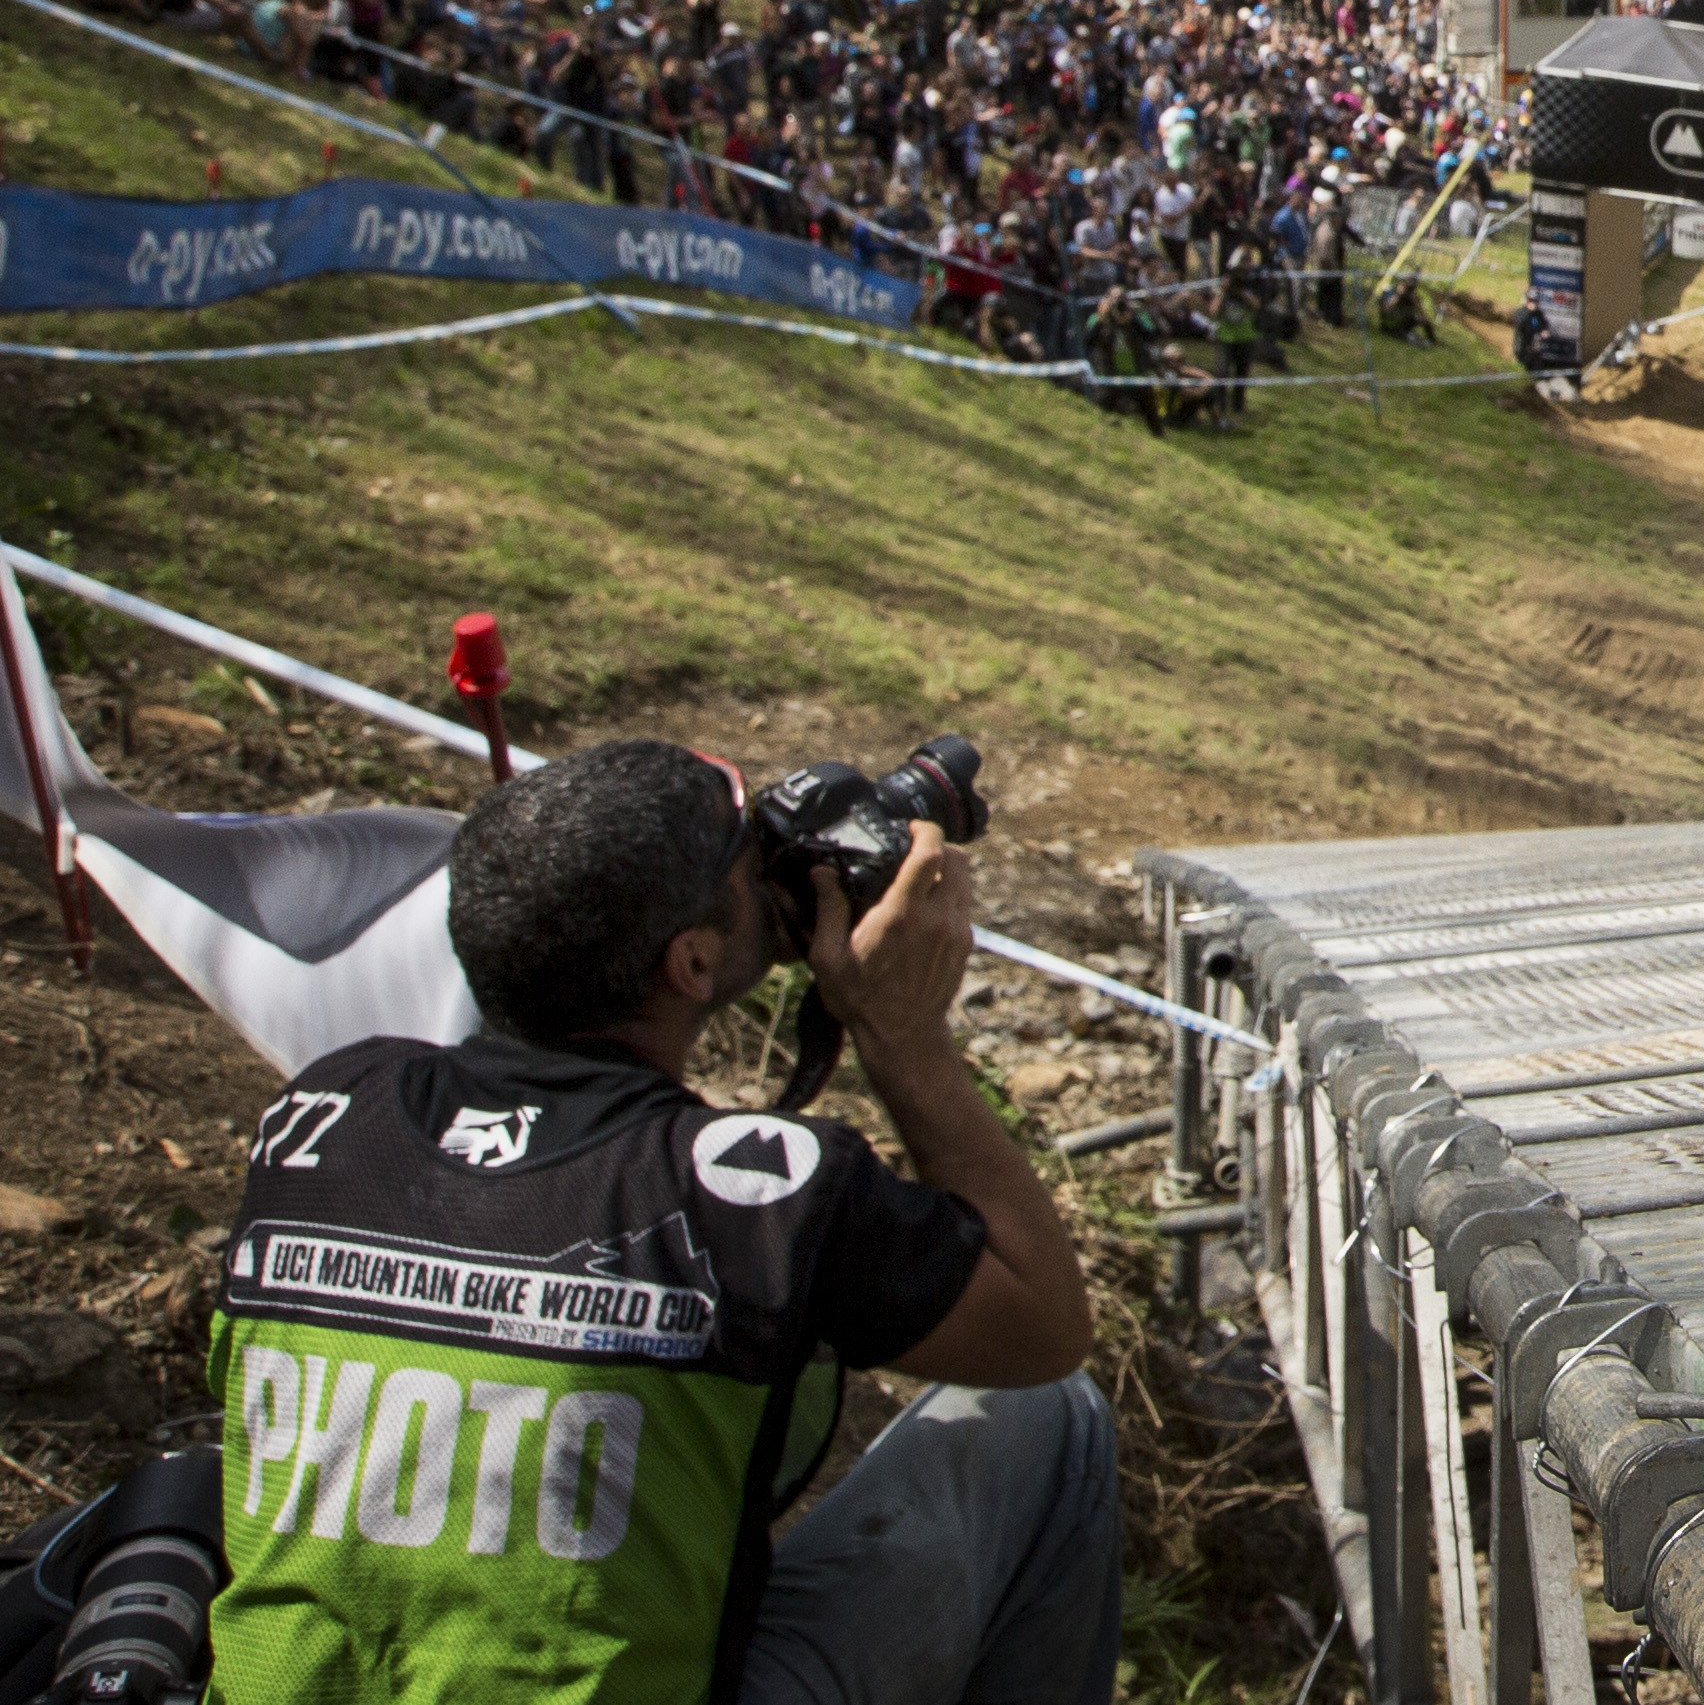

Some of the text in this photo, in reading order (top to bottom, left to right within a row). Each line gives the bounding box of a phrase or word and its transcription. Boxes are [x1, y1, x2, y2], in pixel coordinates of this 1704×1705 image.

[352, 204, 531, 270] n-py.com
[272, 1243, 316, 1283] UCI
[317, 1247, 459, 1305] MOUNTAIN
[462, 1272, 531, 1315] BIKE
[540, 1280, 652, 1329] WORLD
[560, 1327, 579, 1347] BY
[582, 1329, 705, 1359] SHIMANO
[242, 1346, 645, 1562] PHOTO
